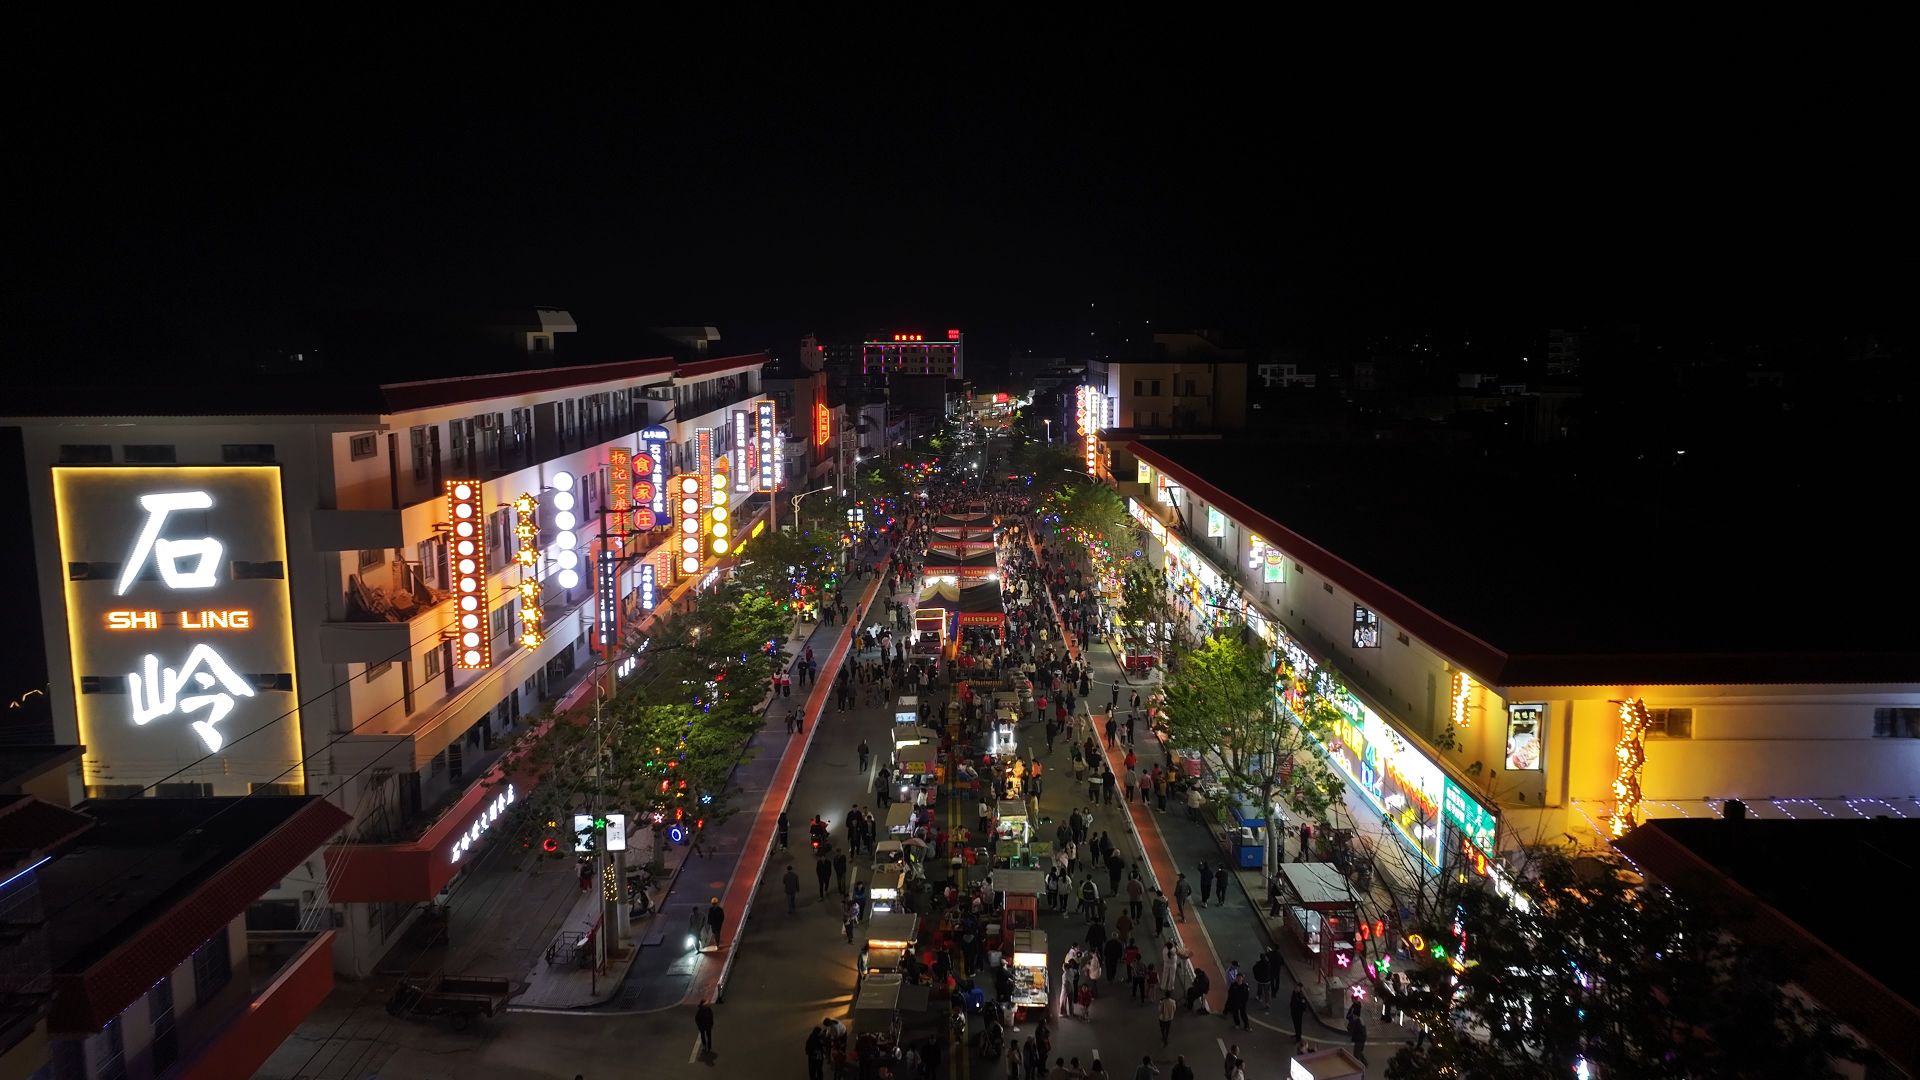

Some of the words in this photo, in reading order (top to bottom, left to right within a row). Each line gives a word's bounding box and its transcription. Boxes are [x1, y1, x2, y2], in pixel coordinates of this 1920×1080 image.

[611, 451, 629, 540] 杨记石磨
[634, 457, 652, 527] 食家庄
[116, 491, 223, 596] 石
[107, 611, 158, 629] SHI
[181, 610, 249, 629] LING
[128, 643, 255, 753] 岭
